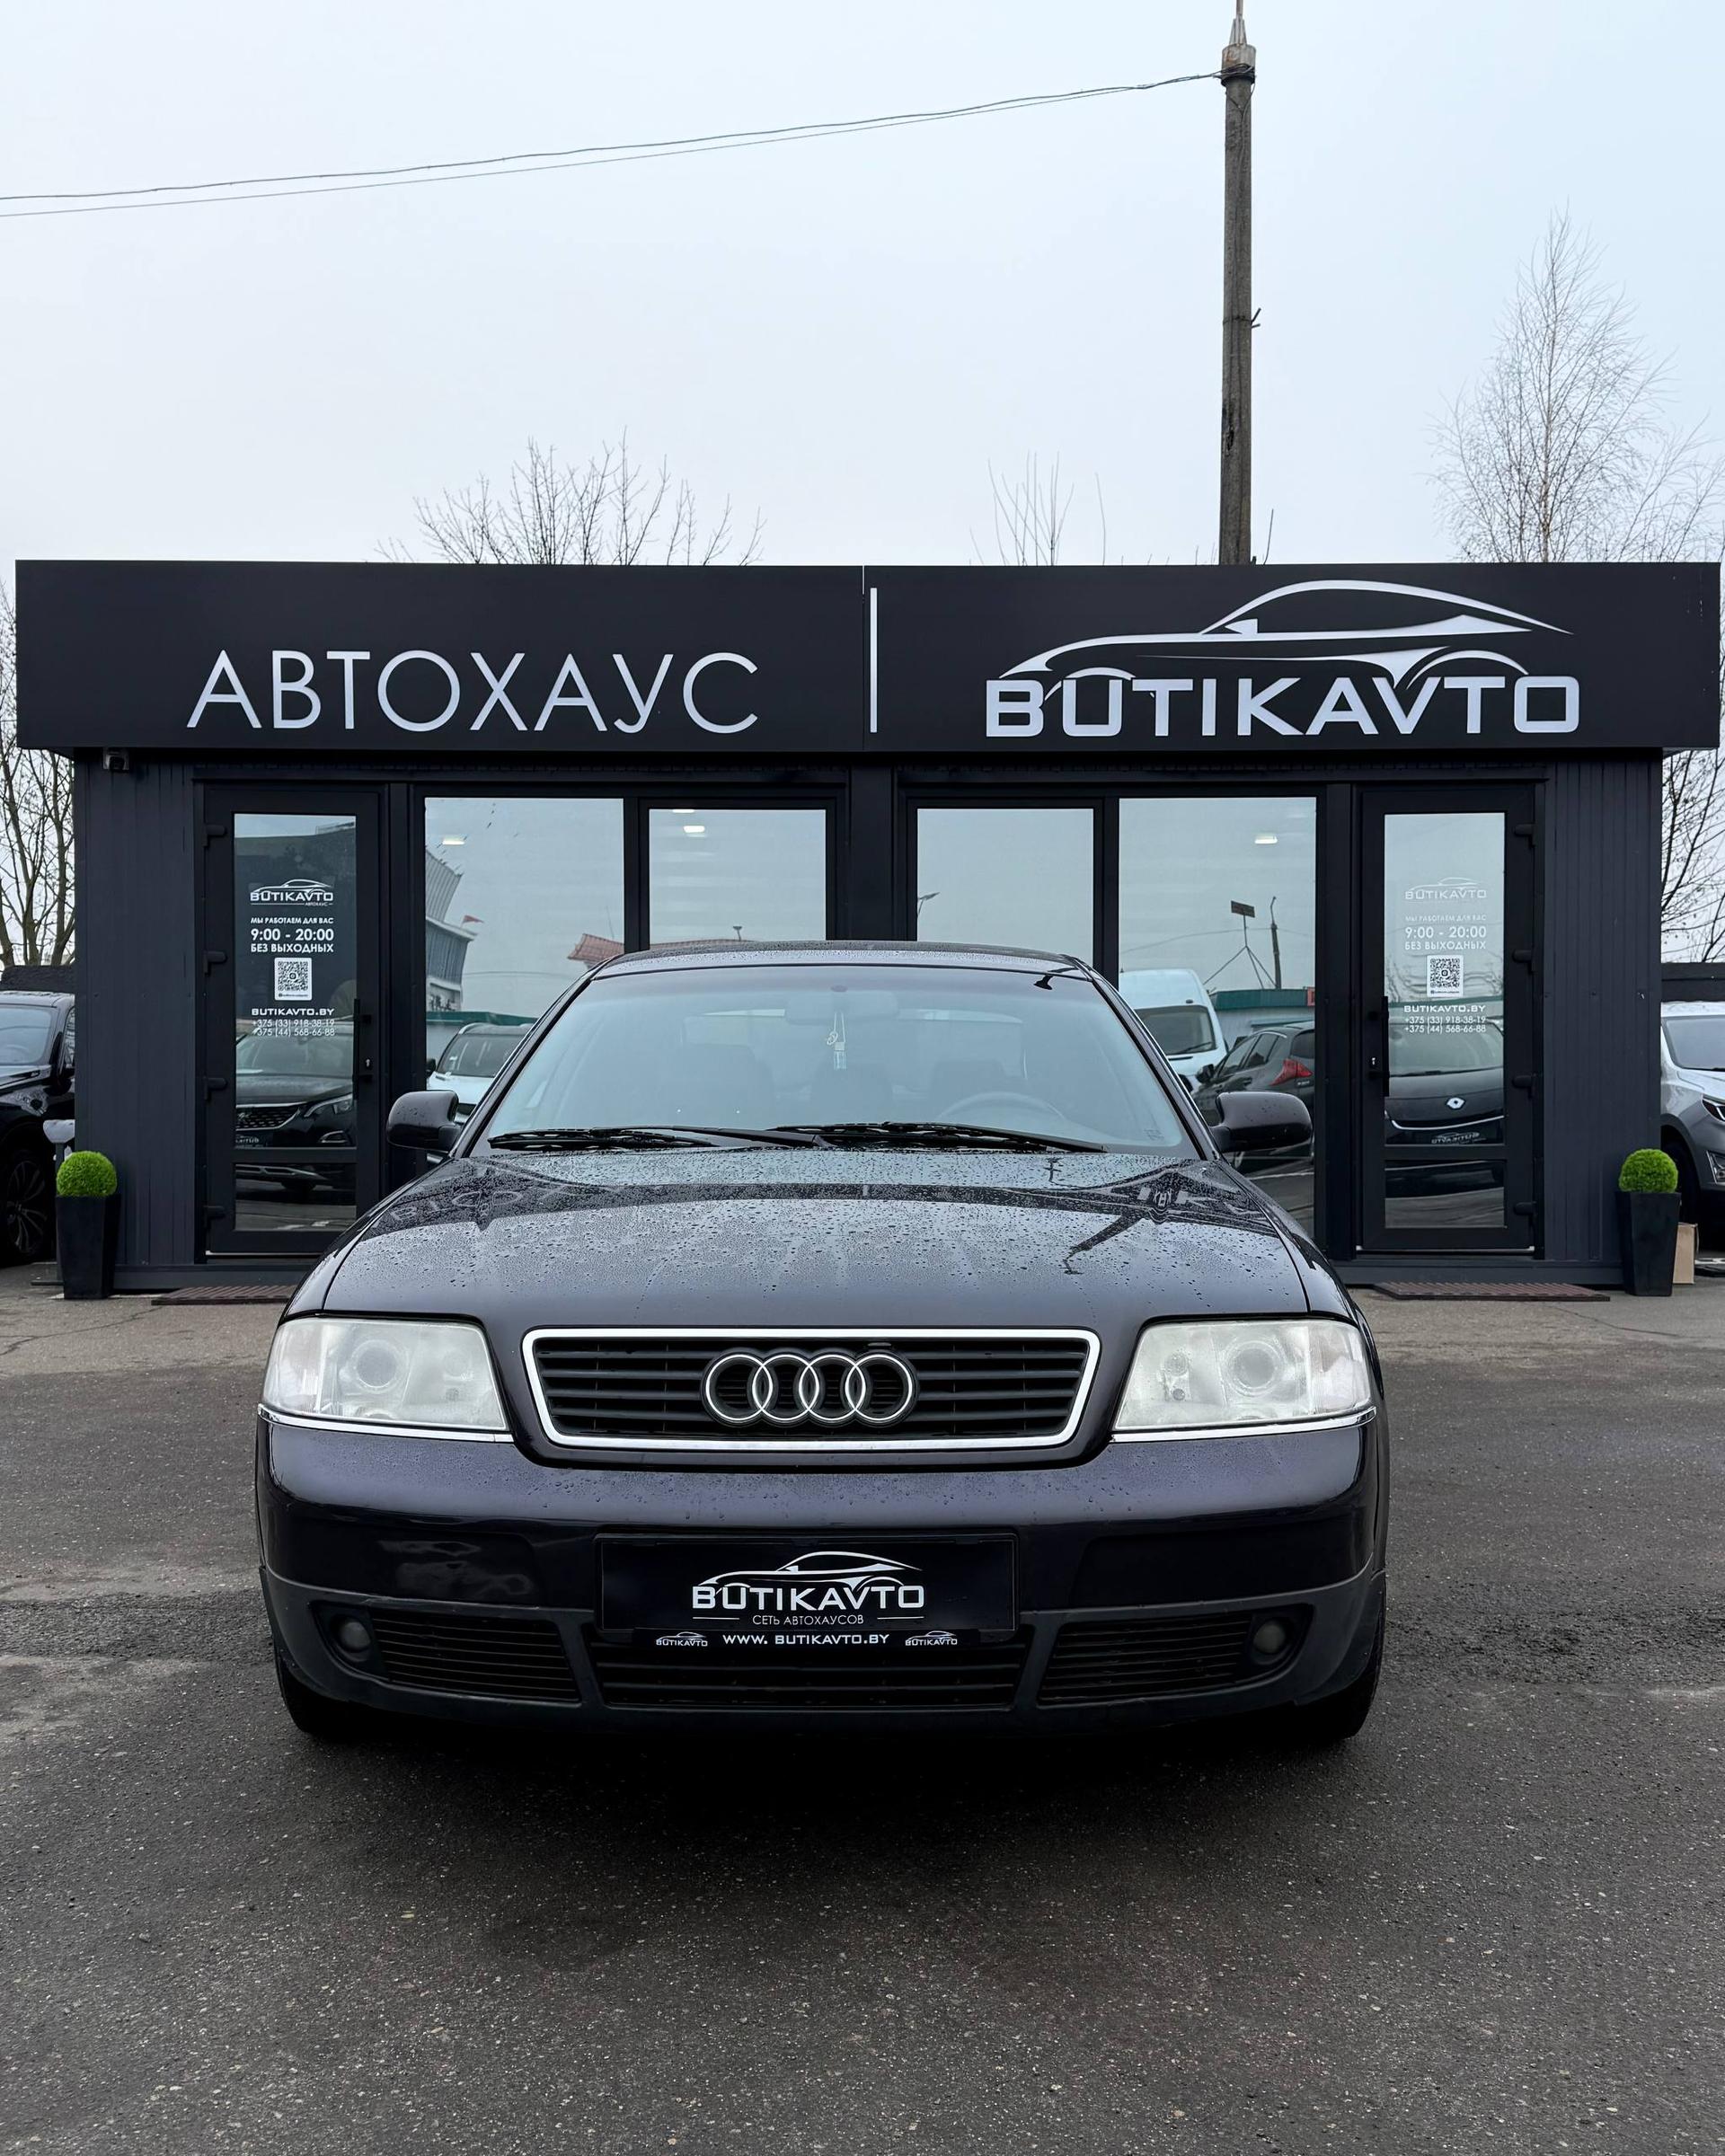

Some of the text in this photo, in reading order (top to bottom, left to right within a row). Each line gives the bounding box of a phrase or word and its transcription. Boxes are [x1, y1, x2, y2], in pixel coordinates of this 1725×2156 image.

[187, 649, 759, 734] АВТОХАУС
[986, 676, 1579, 737] BUTIKAVTO
[251, 891, 333, 901] BUTIKAVTO
[1405, 890, 1487, 899] BUTIKAVTO
[251, 928, 281, 941] 9:00
[296, 928, 334, 941] 20:00
[1405, 926, 1434, 938] 9:00
[1449, 926, 1487, 938] 20:00
[251, 943, 333, 953] БЕЗ ВЫХОДНЫХ
[1405, 941, 1486, 950] БЕЗ ВЫХОДНЫХ
[252, 1008, 334, 1016] BUTIKAVTO.BY
[275, 1019, 291, 1029] (33)
[1405, 1016, 1425, 1024] +375
[1427, 1015, 1443, 1025] (33)
[275, 1028, 291, 1038] (44)
[1405, 1024, 1487, 1034] +375 (44) 568-66-88
[692, 1585, 924, 1611] BUTIKAVTO
[753, 1614, 864, 1626] СЕТЬ АВТОХАУСОВ
[656, 1639, 708, 1647] BUTIKAVTO
[774, 1633, 889, 1645] BUTIKAVTO.BY
[906, 1638, 958, 1646] BUTIKAVTO
